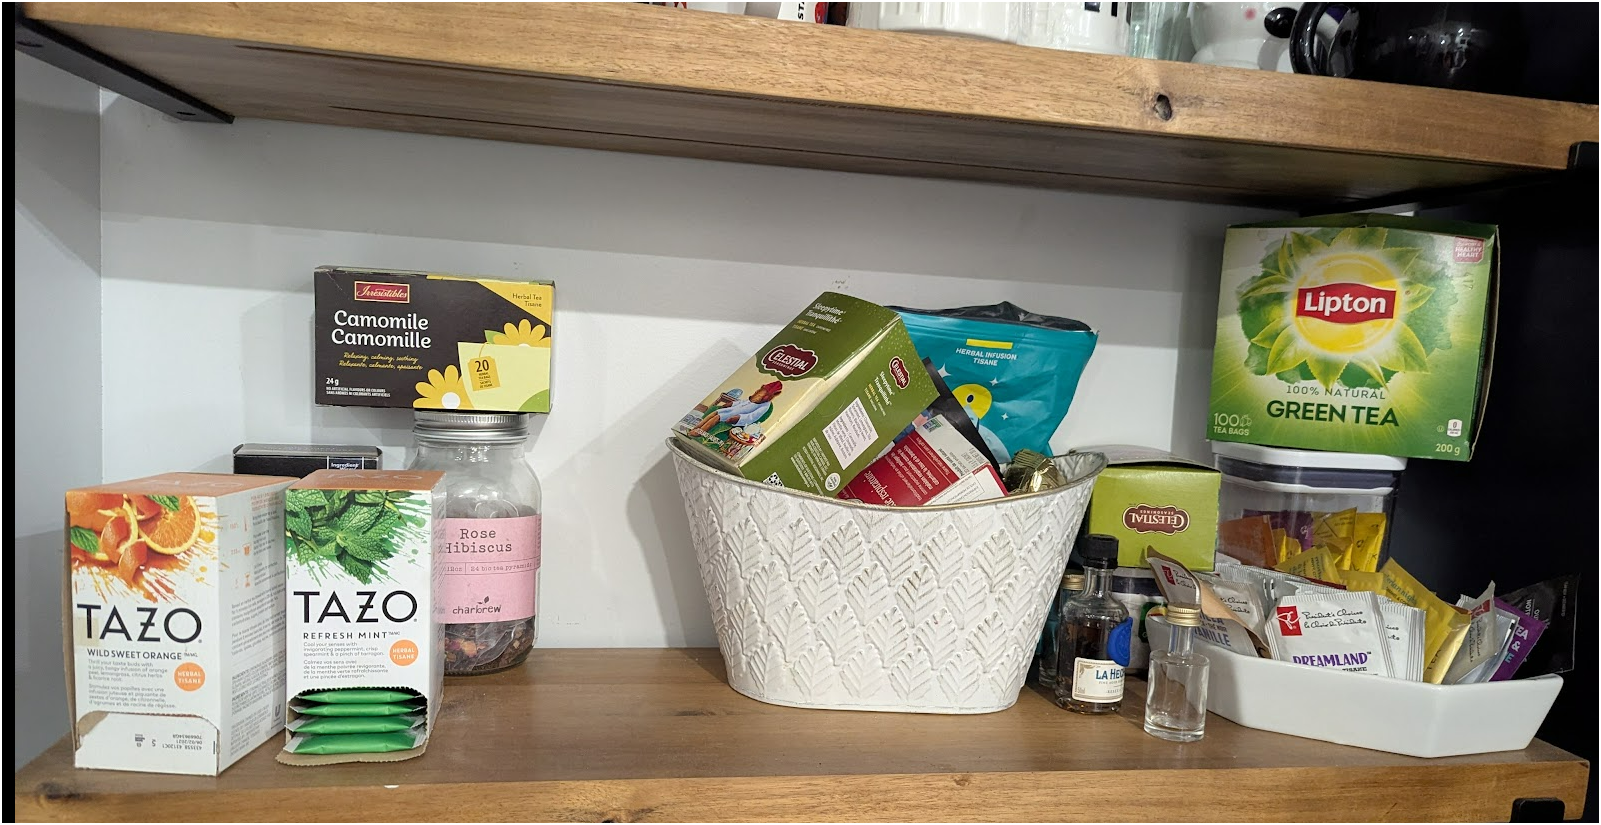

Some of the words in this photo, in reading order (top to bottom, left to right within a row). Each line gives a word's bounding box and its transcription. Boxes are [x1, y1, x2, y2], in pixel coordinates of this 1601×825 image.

[356, 286, 407, 298] Irresistibles
[1304, 292, 1385, 316] Lipton
[334, 310, 429, 330] Camomile
[331, 328, 432, 349] Camomille
[370, 354, 395, 363] calming,
[768, 349, 808, 370] CELESTIAL
[956, 348, 984, 358] HERBAL
[985, 352, 1017, 360] INFUSION
[474, 360, 490, 372] 20
[973, 358, 998, 366] TISANE
[892, 360, 906, 386] CELESTIAL
[1286, 385, 1320, 396] 100%
[1325, 388, 1386, 400] NATURAL
[1266, 400, 1346, 423] GREEN
[1350, 405, 1399, 426] TEA
[1214, 413, 1240, 427] 100
[1213, 426, 1228, 434] TEA
[1228, 427, 1249, 436] BAGS
[1436, 444, 1453, 452] 200
[1454, 447, 1460, 456] g
[864, 470, 889, 500] respiratoire
[1129, 512, 1184, 528] CELESTIAL
[460, 528, 496, 539] Rose
[446, 542, 512, 554] Hibiscus
[506, 563, 532, 572] pyramids
[293, 590, 417, 623] TAZO
[452, 605, 501, 614] charbrew
[1302, 611, 1336, 620] President's
[77, 604, 202, 643] TAZO
[1512, 641, 1521, 652] &
[87, 648, 110, 657] WILD
[142, 652, 182, 660] ORANGE
[1292, 652, 1368, 667] DREAMLAND
[1096, 670, 1108, 679] LA
